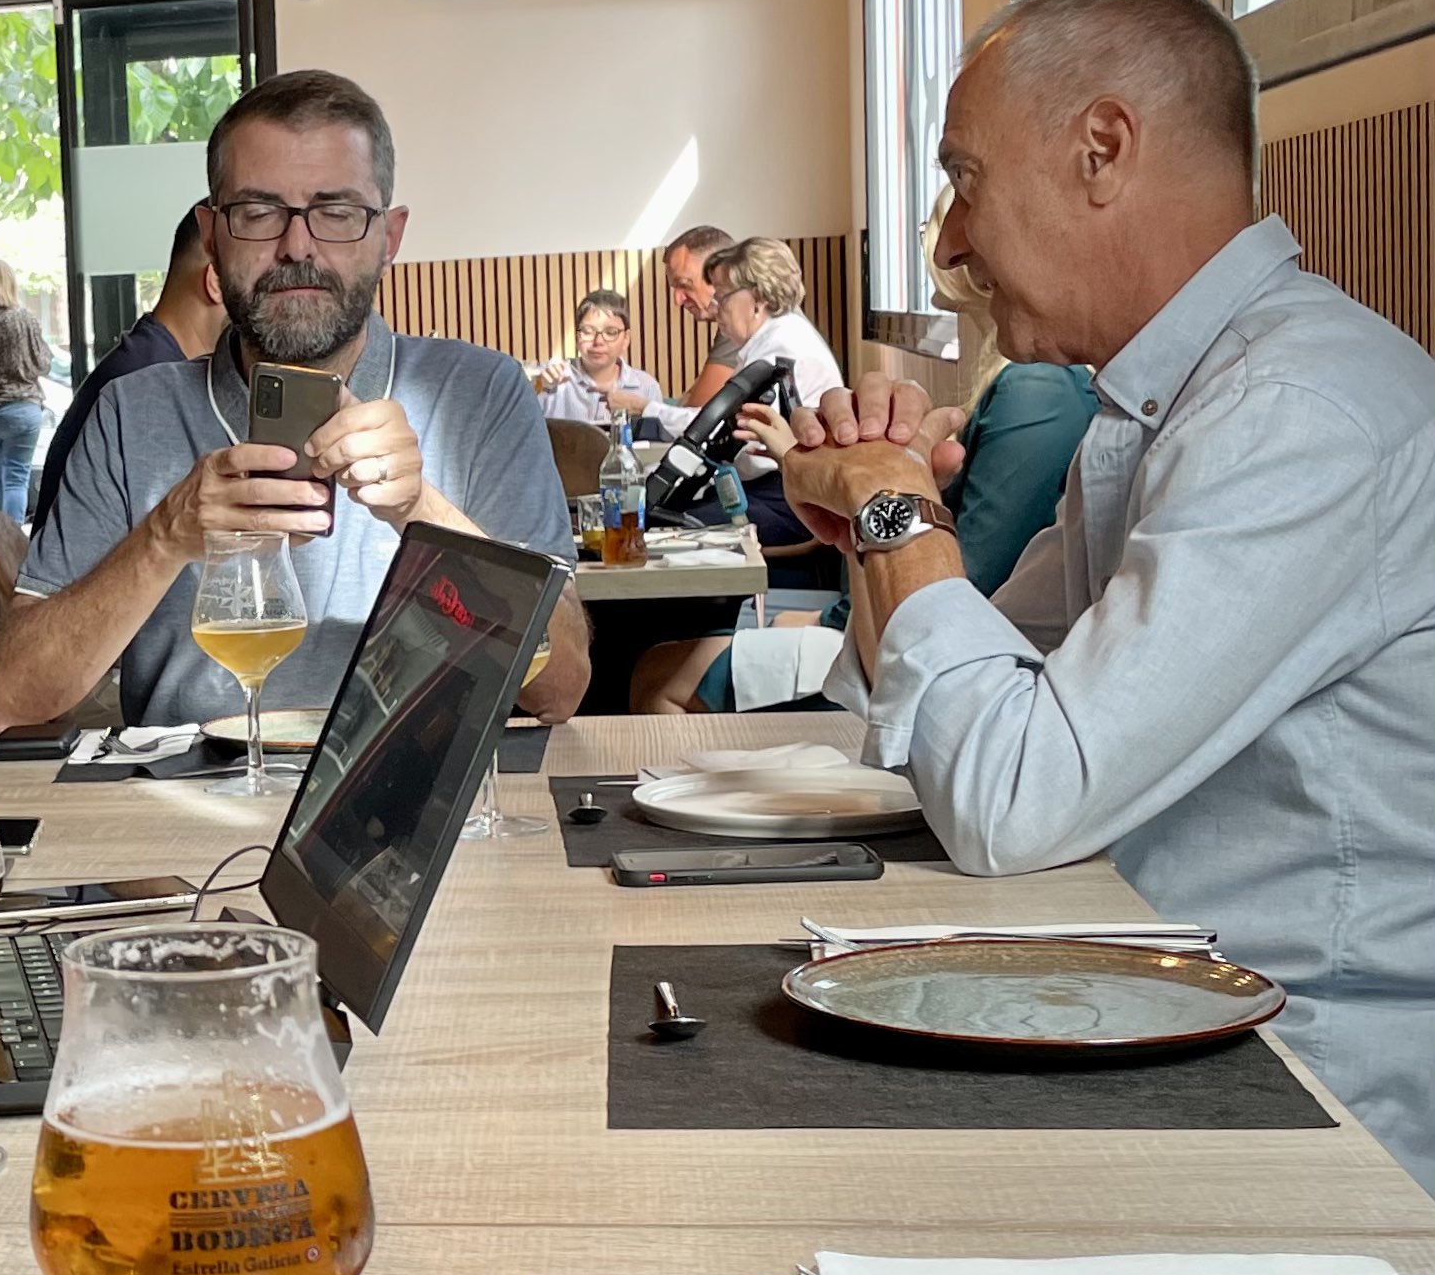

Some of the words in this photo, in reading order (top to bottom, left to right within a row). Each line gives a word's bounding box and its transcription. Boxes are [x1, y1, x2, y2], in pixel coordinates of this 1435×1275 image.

[168, 1178, 310, 1210] CERVEZA
[169, 1217, 316, 1252] BODEGA
[171, 1259, 241, 1275] Estrella
[243, 1253, 302, 1273] Galicia
